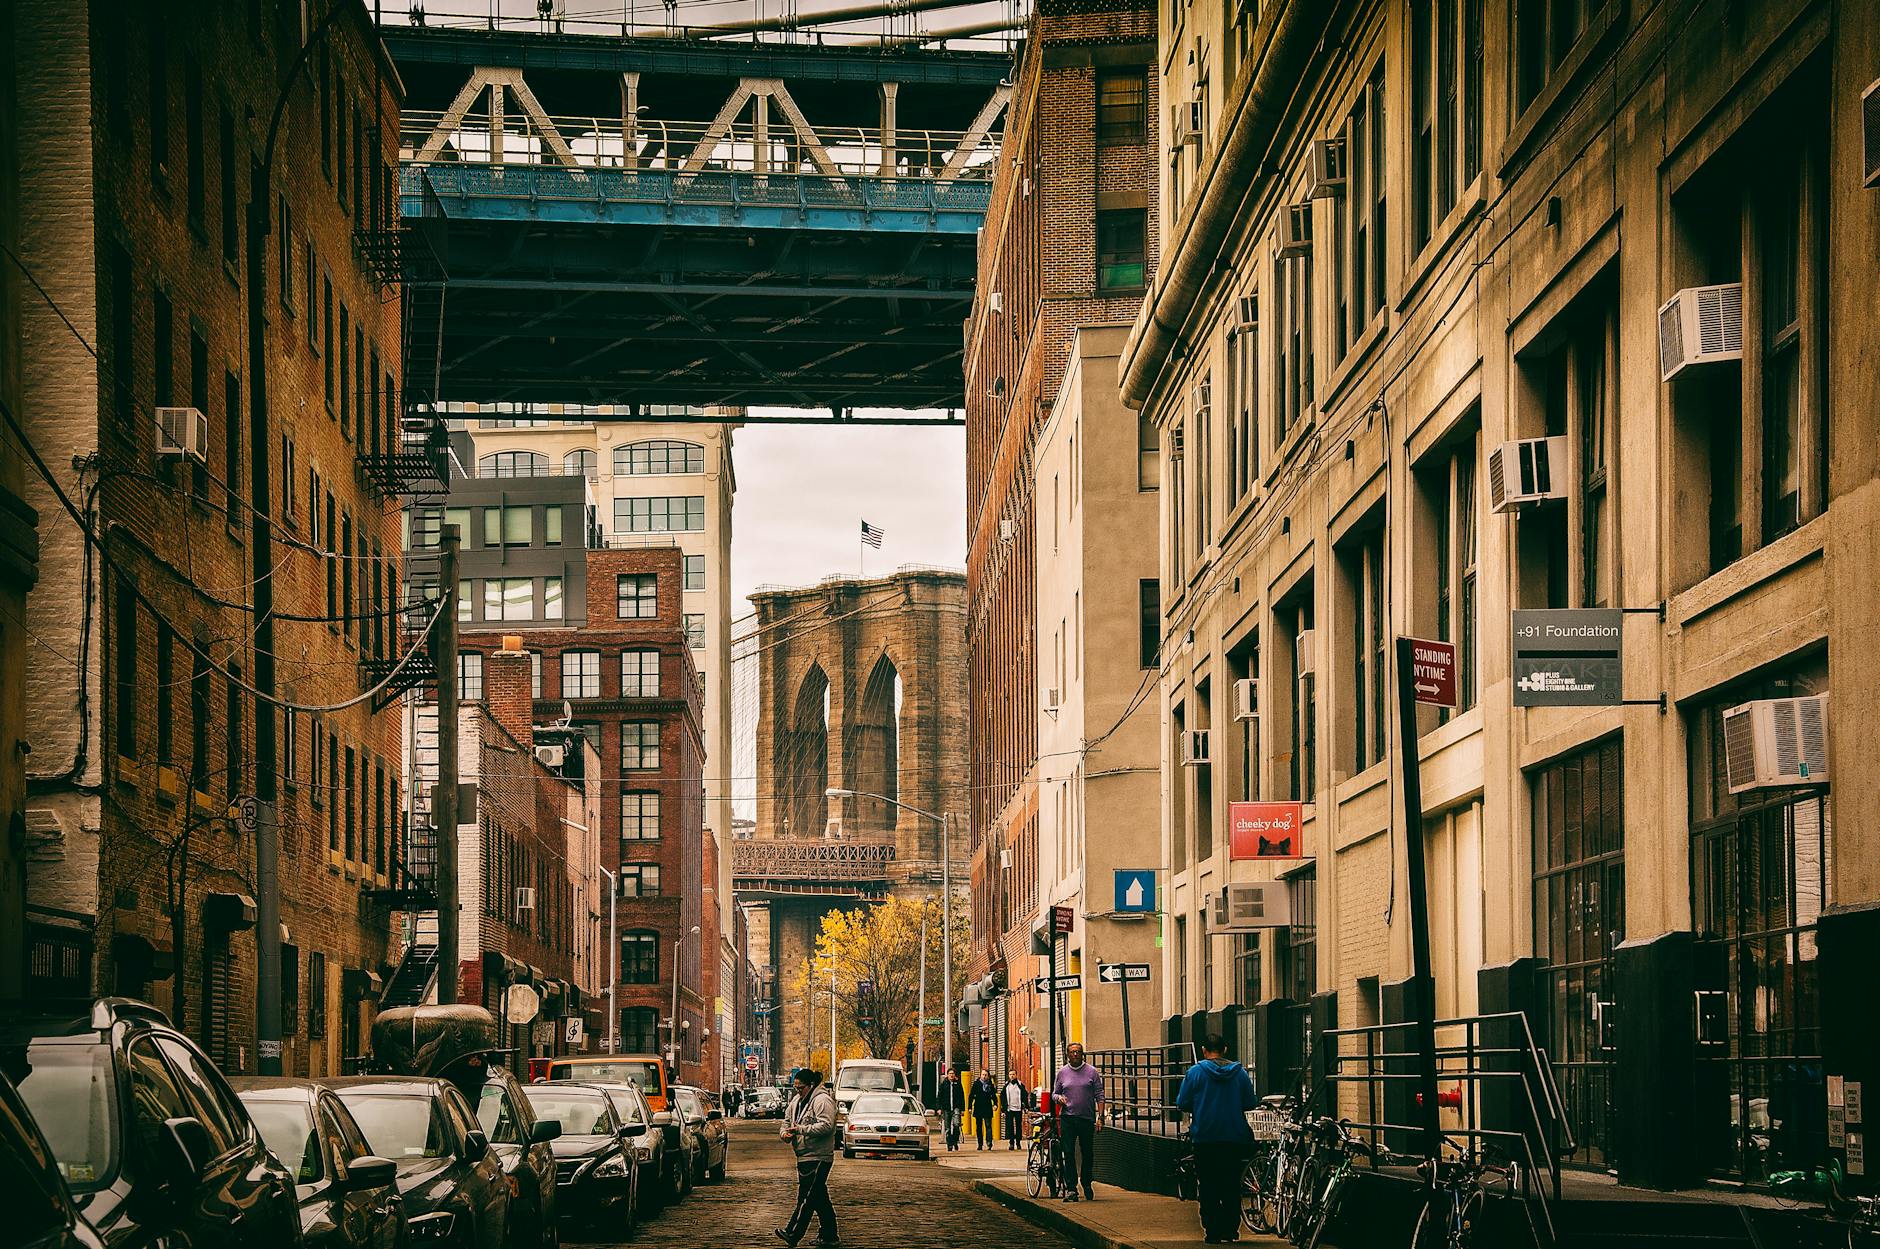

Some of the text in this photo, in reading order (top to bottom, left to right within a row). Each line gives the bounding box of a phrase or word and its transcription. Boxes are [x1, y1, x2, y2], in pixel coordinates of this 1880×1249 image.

[1517, 625, 1619, 638] +91 Foundation
[1414, 647, 1451, 665] STANDING
[1413, 664, 1446, 680] NYTIME
[1545, 671, 1560, 679] PLUS
[1517, 671, 1546, 692] +81
[1545, 684, 1565, 692] STUDIO
[1236, 813, 1292, 831] cheeky dog
[1128, 969, 1145, 977] WAY
[1060, 979, 1075, 987] WAY
